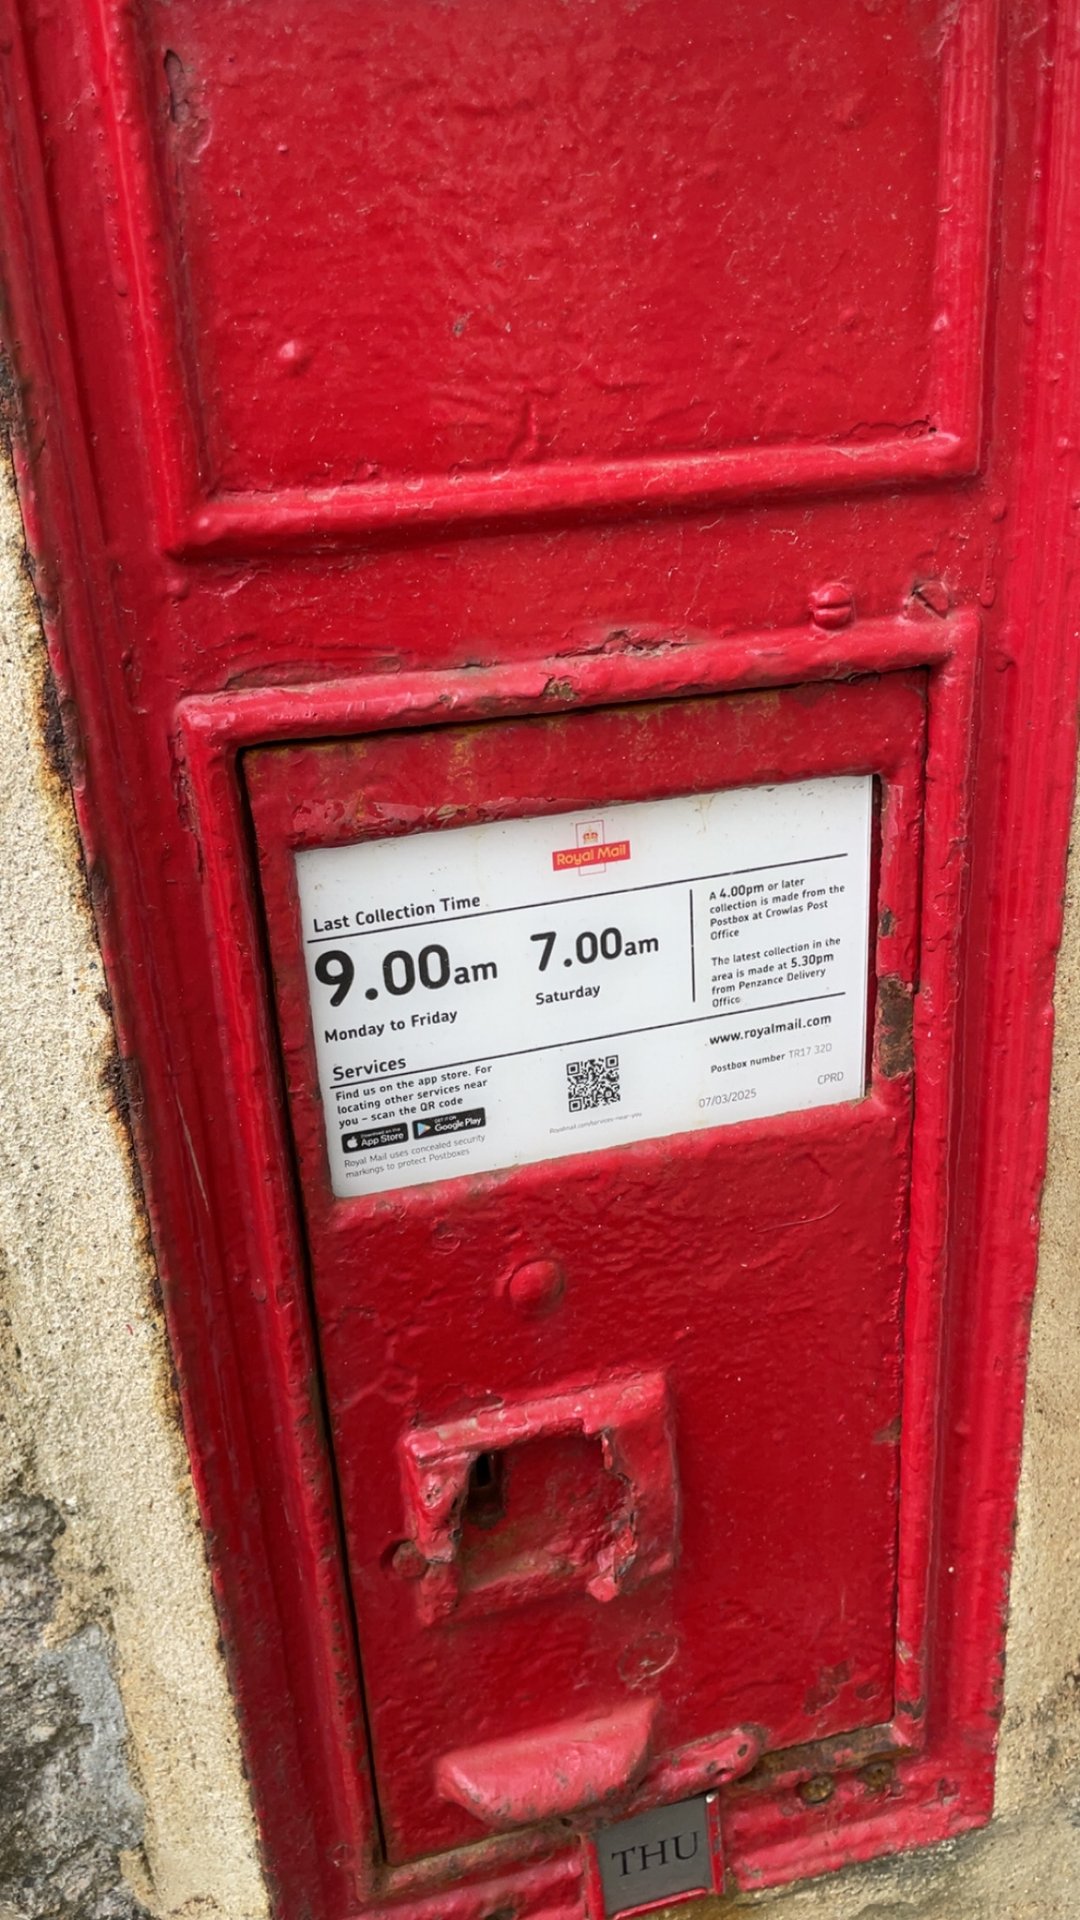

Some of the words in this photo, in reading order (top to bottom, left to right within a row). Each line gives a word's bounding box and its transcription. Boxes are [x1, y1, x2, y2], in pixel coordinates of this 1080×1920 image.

[556, 850, 594, 865] Royal
[598, 844, 627, 858] Mail
[709, 892, 716, 900] A
[719, 884, 764, 898] 4.00pm
[768, 883, 778, 891] or
[782, 878, 805, 889] later
[710, 901, 757, 914] collection
[761, 897, 768, 905] is
[772, 892, 799, 904] made
[802, 889, 825, 899] from
[829, 884, 845, 894] the
[314, 915, 350, 932] Last
[355, 902, 435, 926] Collection
[440, 896, 481, 912] Time
[710, 914, 749, 927] Postbox
[752, 911, 762, 920] at
[766, 904, 803, 918] Crowlas
[807, 900, 828, 911] Post
[711, 928, 739, 940] Office
[530, 927, 659, 972] 7.00am
[711, 957, 730, 966] The
[733, 950, 760, 963] latest
[764, 942, 809, 957] collection
[813, 940, 821, 949] in
[826, 937, 841, 946] the
[314, 944, 498, 1007] 9.00am
[712, 972, 733, 982] area
[736, 969, 744, 978] is
[748, 963, 774, 975] made
[778, 962, 788, 970] at
[791, 952, 834, 968] 5.30pm
[712, 986, 735, 994] from
[738, 976, 783, 990] Penzance
[787, 967, 826, 982] Delivery
[535, 985, 600, 1005] Saturday
[712, 997, 741, 1008] Office
[324, 1023, 385, 1043] Monday
[390, 1020, 406, 1032] to
[411, 1010, 458, 1028] Friday
[709, 1014, 832, 1045] www.royalmail.com
[333, 1058, 406, 1081] Services
[711, 1061, 746, 1073] Postbox
[750, 1053, 785, 1066] number
[789, 1046, 811, 1058] TR17
[336, 1090, 359, 1101] Find
[363, 1086, 376, 1096] us
[380, 1083, 393, 1092] on
[397, 1079, 414, 1089] the
[418, 1075, 437, 1086] app
[441, 1070, 471, 1081] store.
[475, 1065, 492, 1075] For
[817, 1071, 844, 1085] CPRD
[337, 1099, 380, 1114] locating
[385, 1093, 414, 1105] other
[417, 1086, 460, 1099] services
[464, 1080, 488, 1090] near
[699, 1088, 757, 1108] 07/03/2025
[339, 1118, 358, 1129] you
[371, 1111, 395, 1122] scan
[399, 1106, 416, 1116] the
[420, 1102, 435, 1111] QR
[439, 1097, 463, 1108] code
[435, 1120, 464, 1131] Google
[465, 1118, 481, 1126] Play
[344, 1157, 366, 1168] Royal
[370, 1153, 387, 1163] Mail
[390, 1150, 408, 1159] uses
[411, 1141, 451, 1155] concealed
[453, 1134, 485, 1146] security
[361, 1138, 379, 1146] App
[381, 1133, 404, 1143] Store
[346, 1165, 384, 1178] markings
[398, 1156, 426, 1169] protect
[429, 1148, 470, 1161] Postboxes
[611, 1831, 698, 1877] THU
